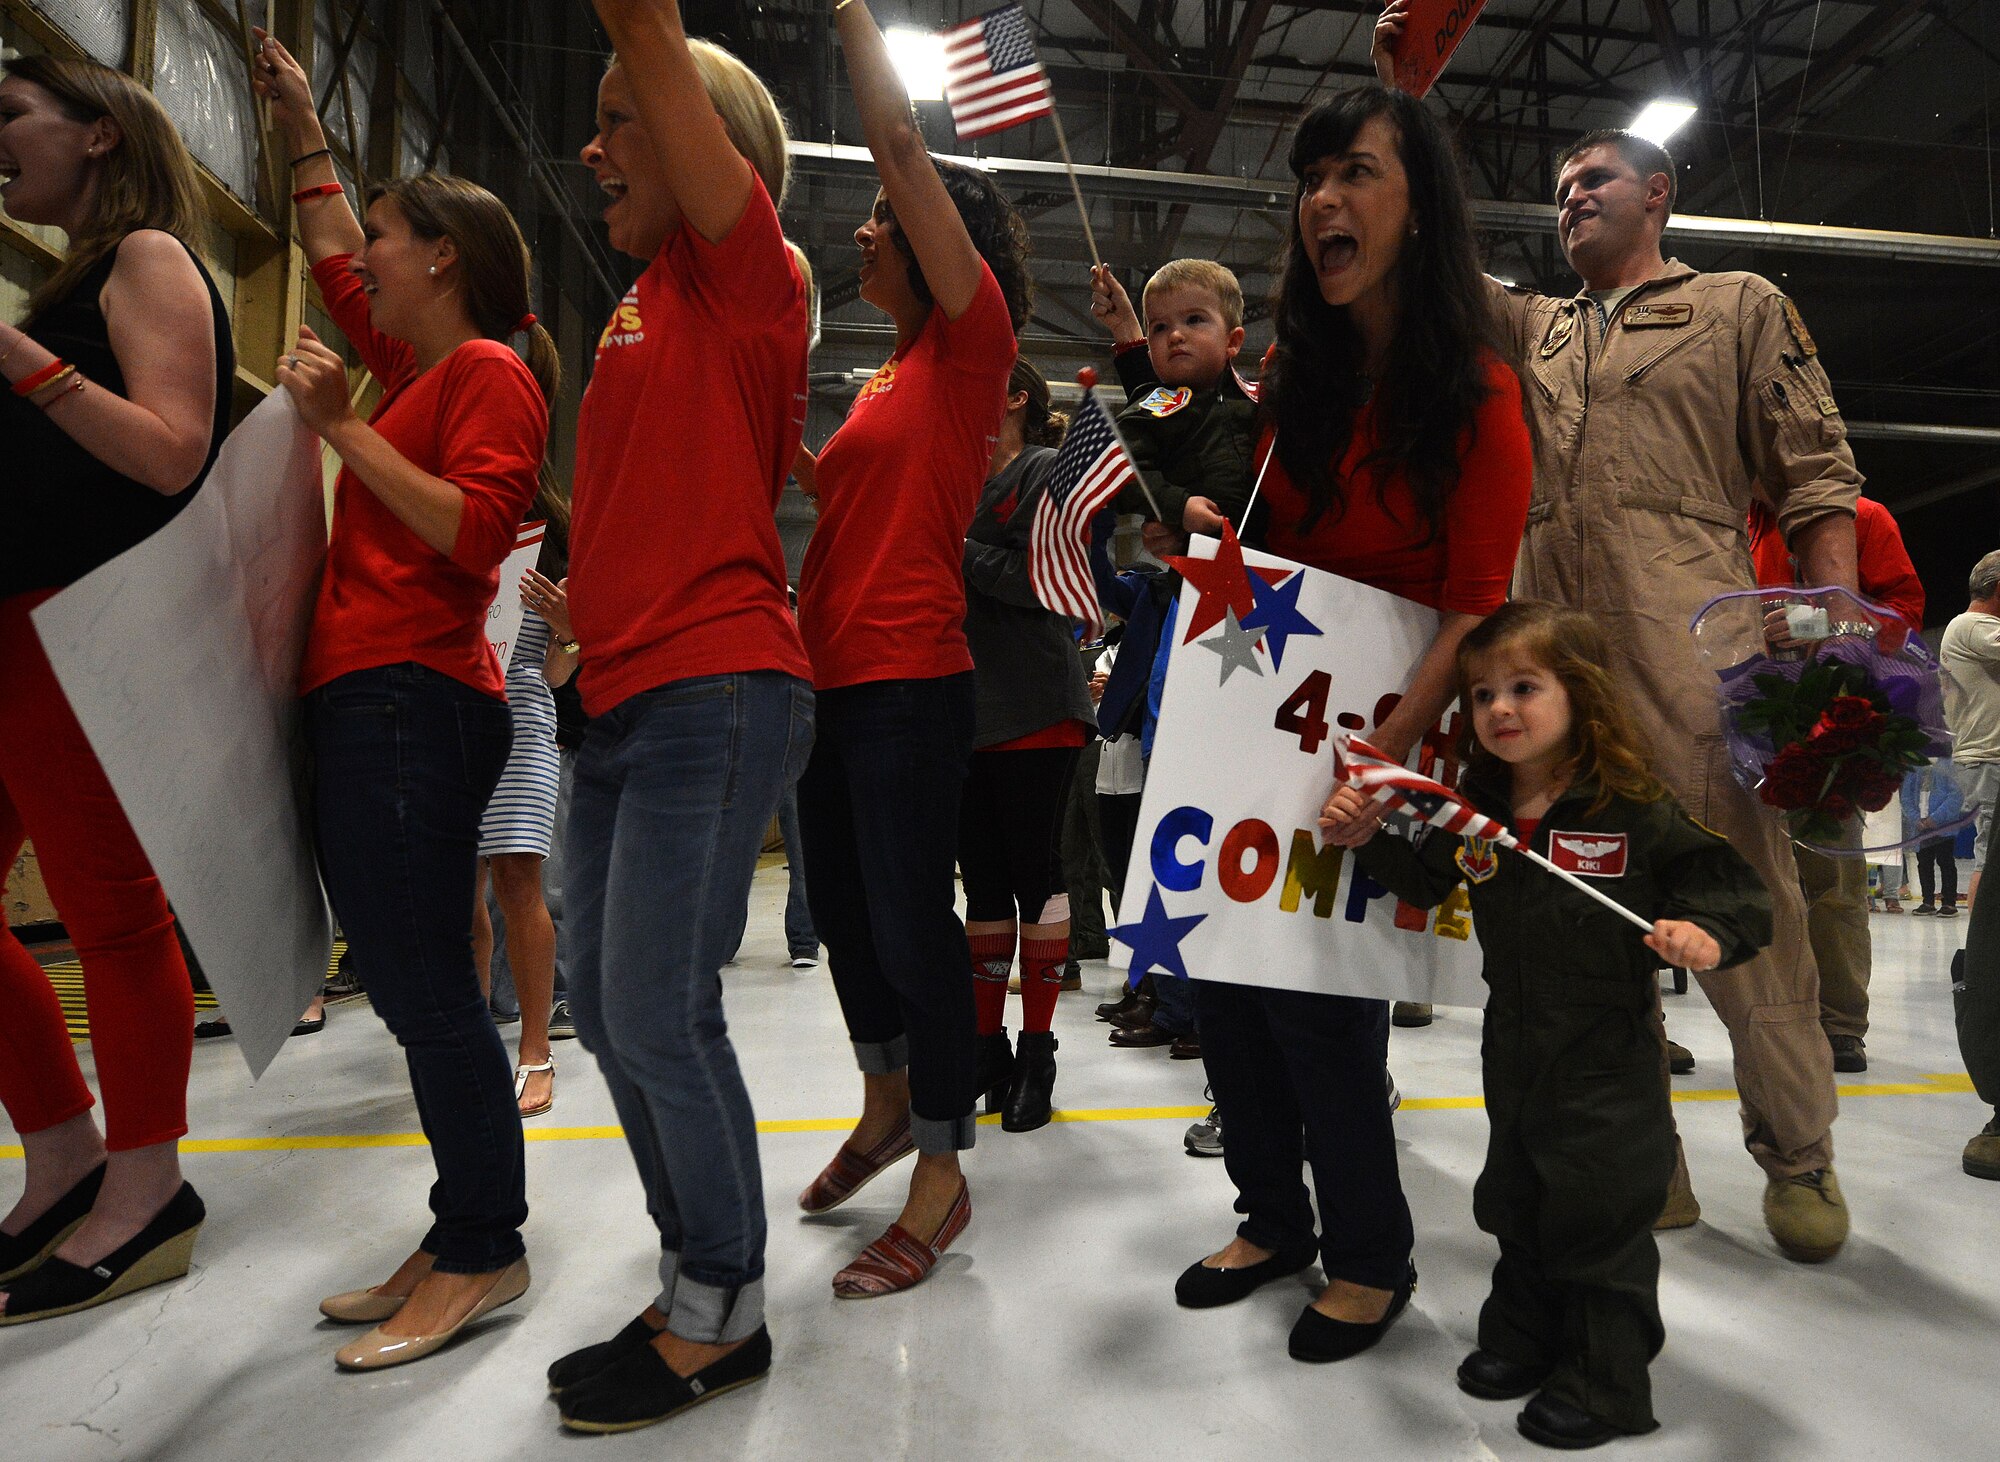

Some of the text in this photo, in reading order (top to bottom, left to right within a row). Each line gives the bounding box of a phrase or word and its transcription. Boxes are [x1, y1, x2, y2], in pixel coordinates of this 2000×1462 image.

[1435, 0, 1476, 57] DOU
[605, 332, 645, 348] PYRO
[1577, 860, 1600, 870] KIKI
